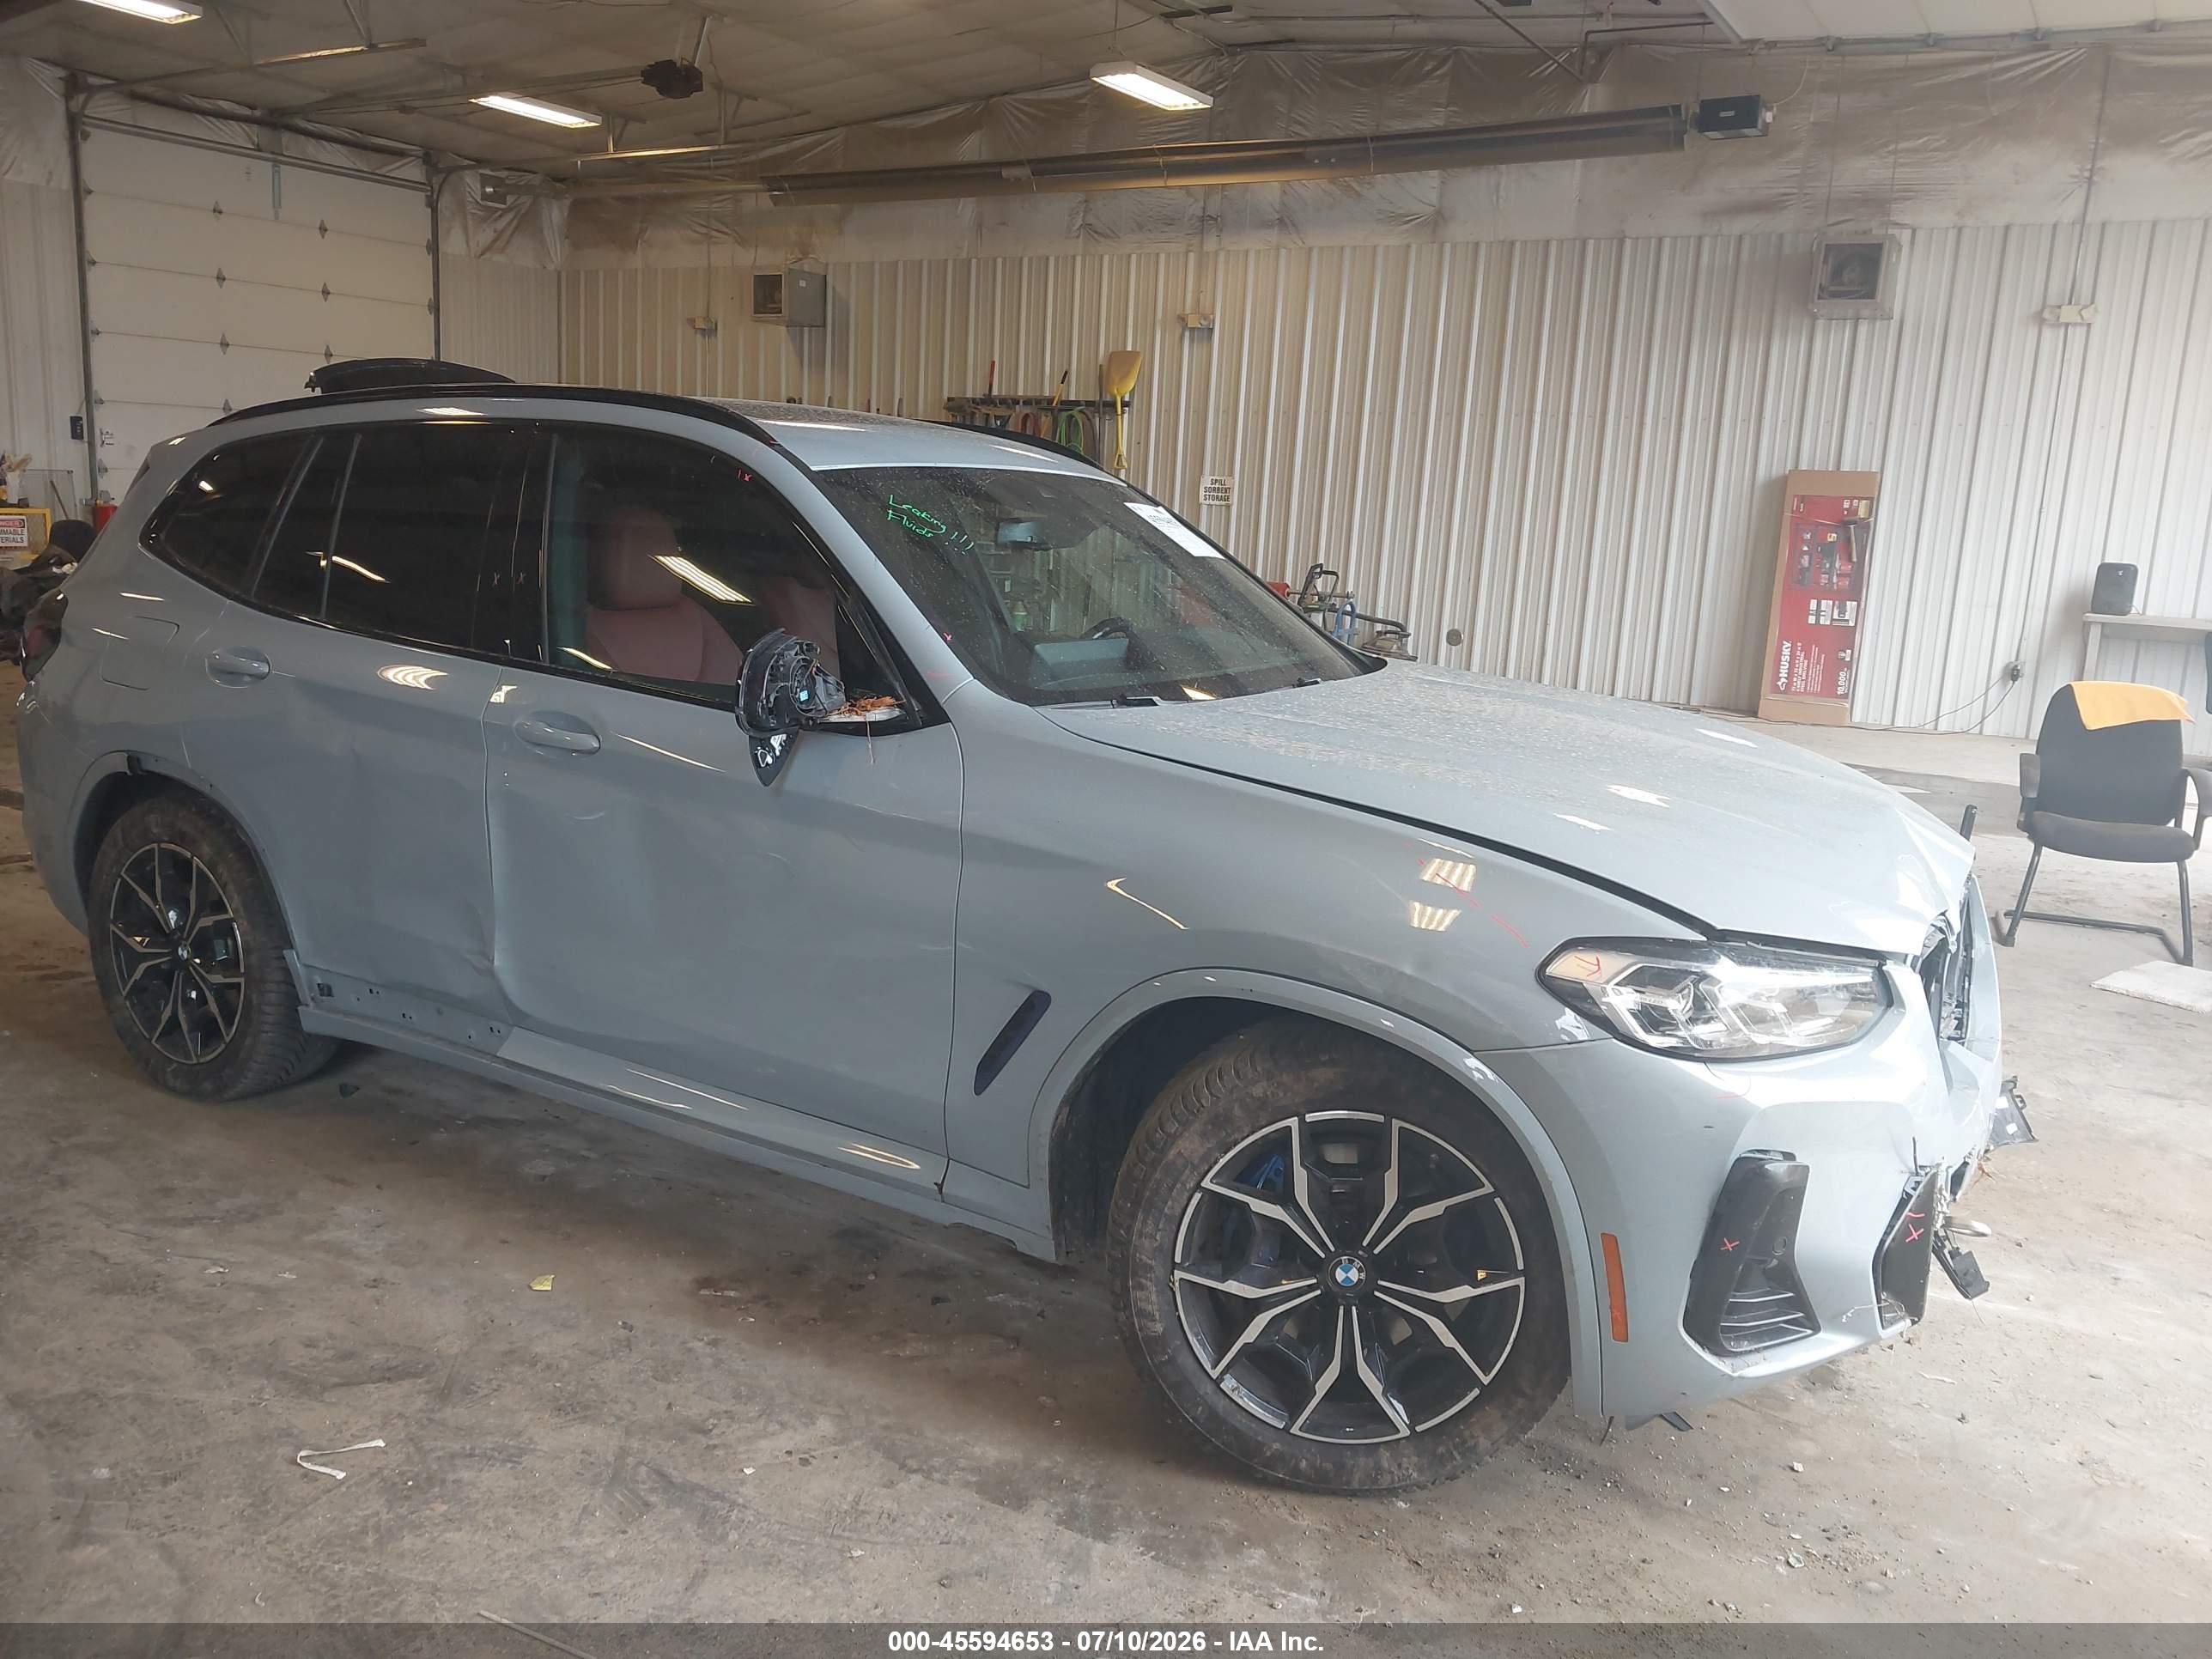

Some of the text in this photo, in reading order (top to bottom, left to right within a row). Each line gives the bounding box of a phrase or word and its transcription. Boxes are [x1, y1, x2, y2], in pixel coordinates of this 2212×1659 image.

[1203, 486, 1231, 495] SORBENT
[1203, 494, 1231, 502] STORAGE
[1778, 641, 1791, 678] HUSKY
